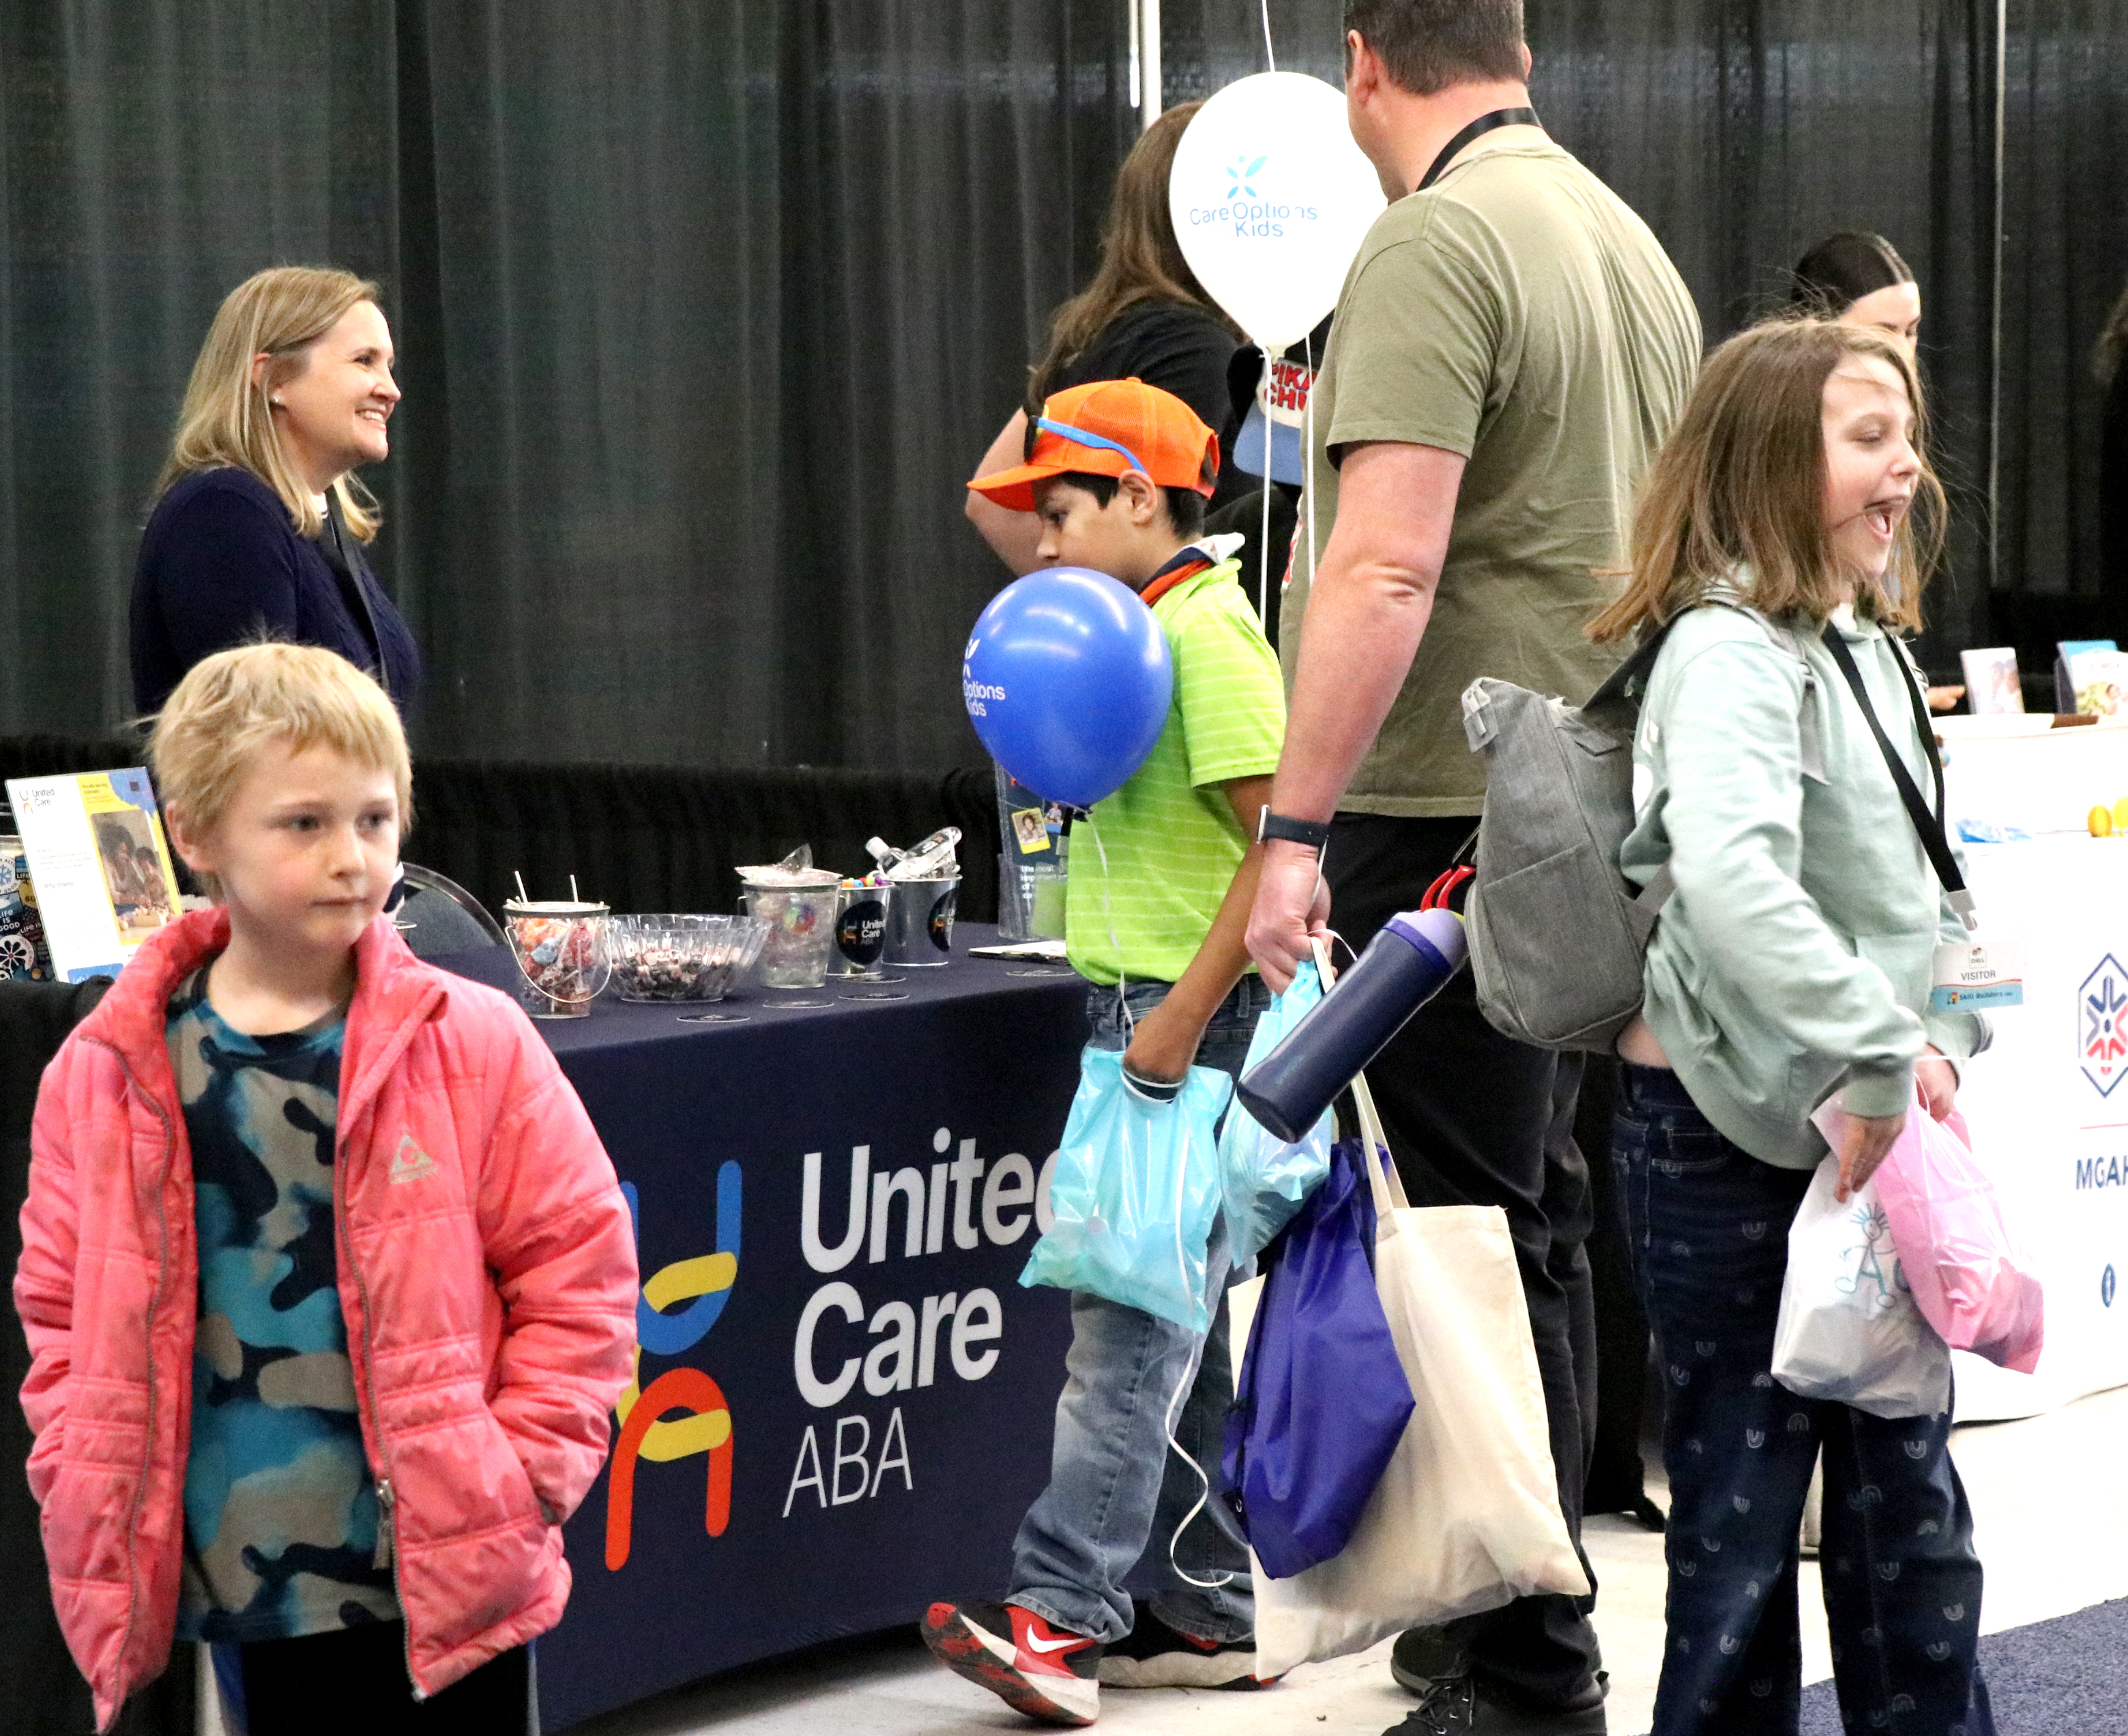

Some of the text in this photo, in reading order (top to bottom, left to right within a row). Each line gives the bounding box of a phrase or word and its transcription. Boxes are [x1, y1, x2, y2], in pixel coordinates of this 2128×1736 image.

[1190, 202, 1317, 225] Care Options
[1235, 220, 1283, 237] Kids
[31, 787, 55, 798] United
[35, 798, 51, 807] Care
[862, 919, 886, 930] United
[861, 929, 881, 938] Care
[1960, 970, 1996, 981] VISITOR
[793, 1282, 1002, 1408] Care
[782, 1406, 913, 1518] ABA
